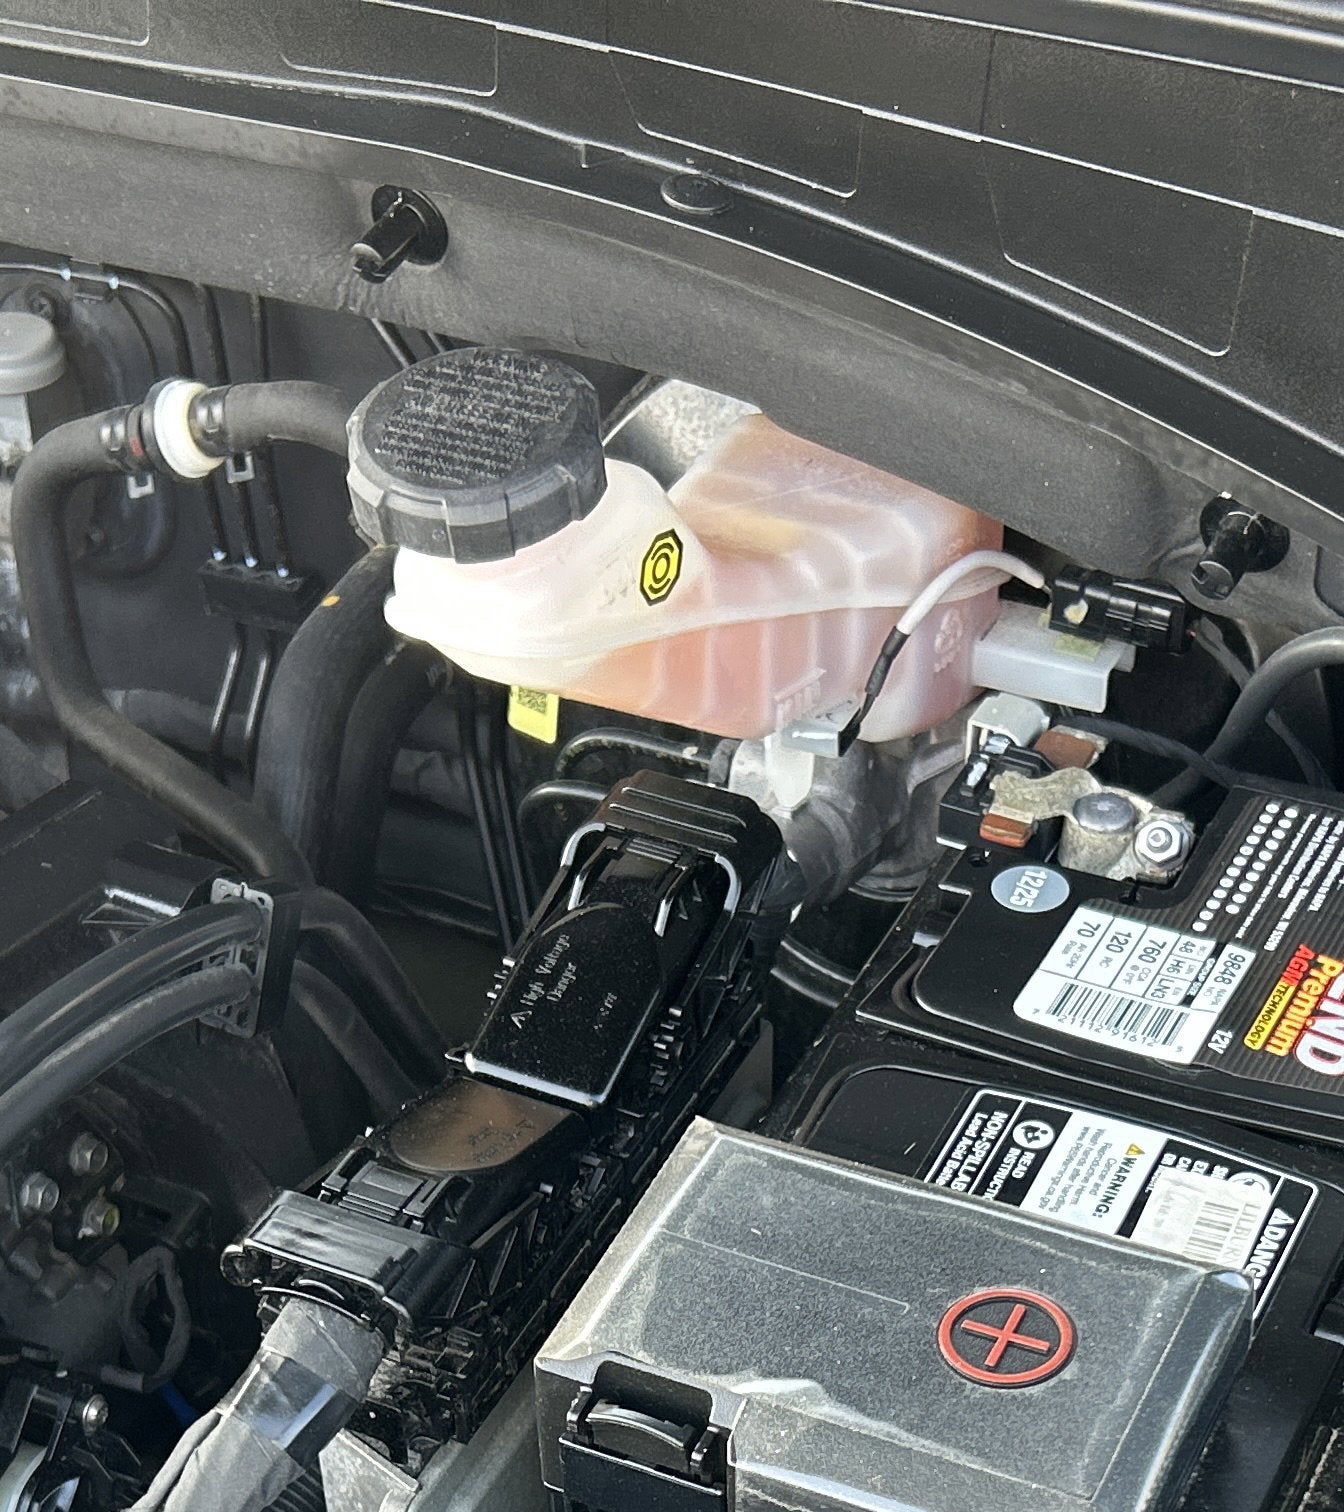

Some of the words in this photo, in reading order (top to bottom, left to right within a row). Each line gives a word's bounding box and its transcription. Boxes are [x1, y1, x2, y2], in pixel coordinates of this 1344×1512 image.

[1010, 871, 1047, 907] 12/25
[1077, 921, 1101, 937] 70
[1105, 931, 1131, 953] 120
[1138, 939, 1166, 963] 760
[1178, 940, 1196, 953] 48
[1136, 967, 1151, 981] CCA
[1166, 958, 1185, 974] H6
[1213, 952, 1245, 984] 9848
[1278, 942, 1319, 987] AGM
[1150, 977, 1174, 998] LN3
[1244, 984, 1290, 1045] TECHNOLOGY
[1207, 1029, 1232, 1053] 12V
[964, 1112, 987, 1137] Lead
[951, 1136, 972, 1159] Acid
[1011, 1151, 1034, 1178] READ
[1098, 1157, 1117, 1181] Cancer
[1088, 1182, 1101, 1196] and
[1092, 1157, 1136, 1217] WARNING:
